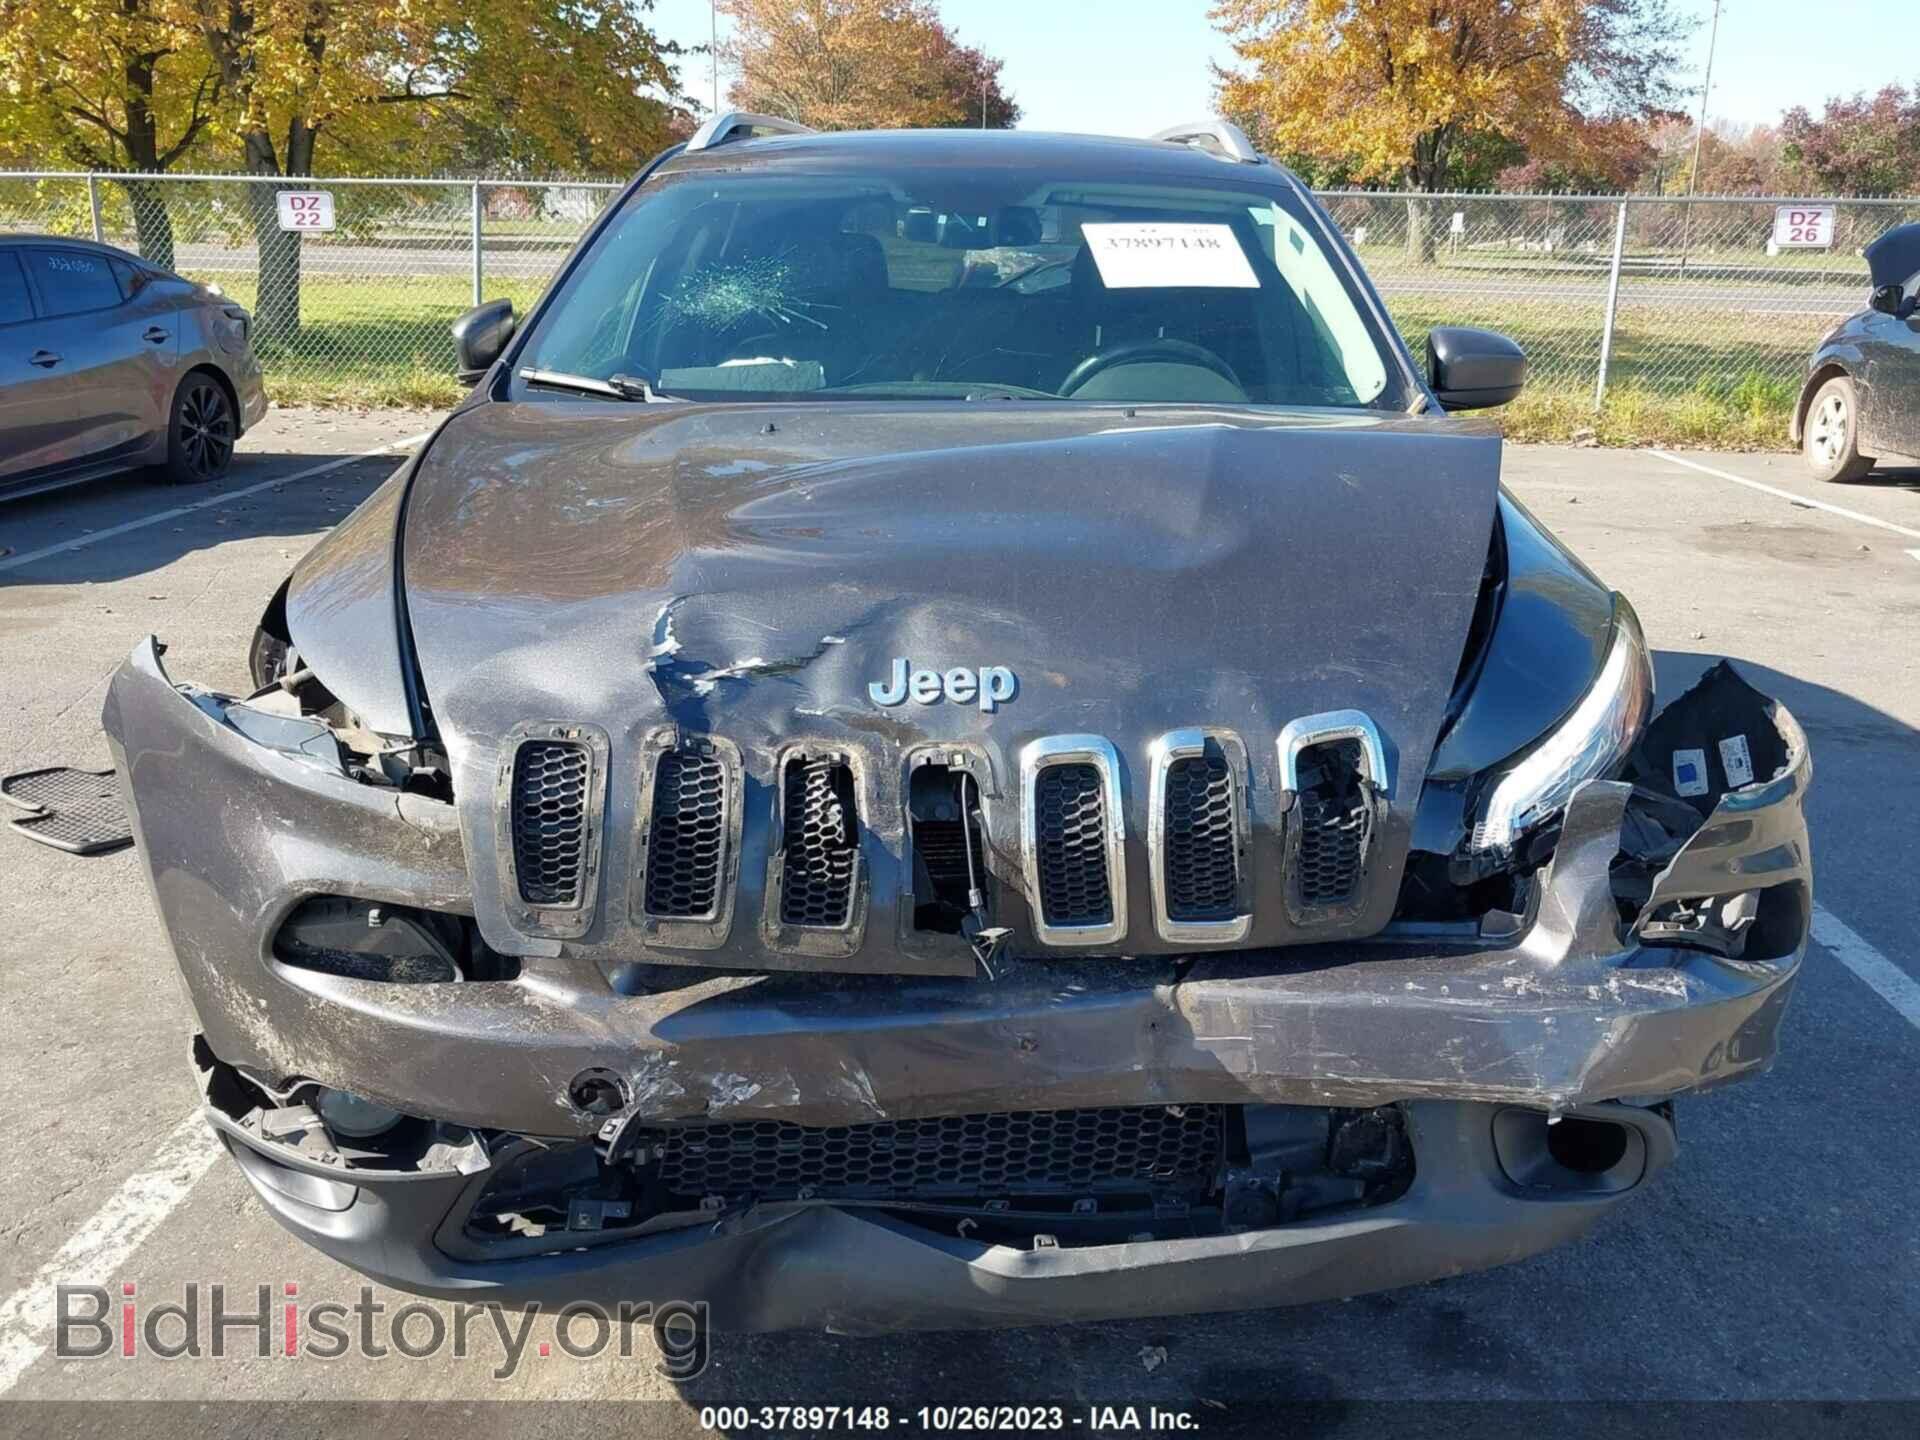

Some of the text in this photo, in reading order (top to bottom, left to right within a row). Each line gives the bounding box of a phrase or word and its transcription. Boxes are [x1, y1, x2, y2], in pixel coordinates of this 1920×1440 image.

[290, 196, 320, 211] DZ
[294, 212, 321, 226] 22
[1789, 211, 1823, 226] DZ
[1789, 228, 1817, 242] 26
[868, 656, 1016, 712] Jeep
